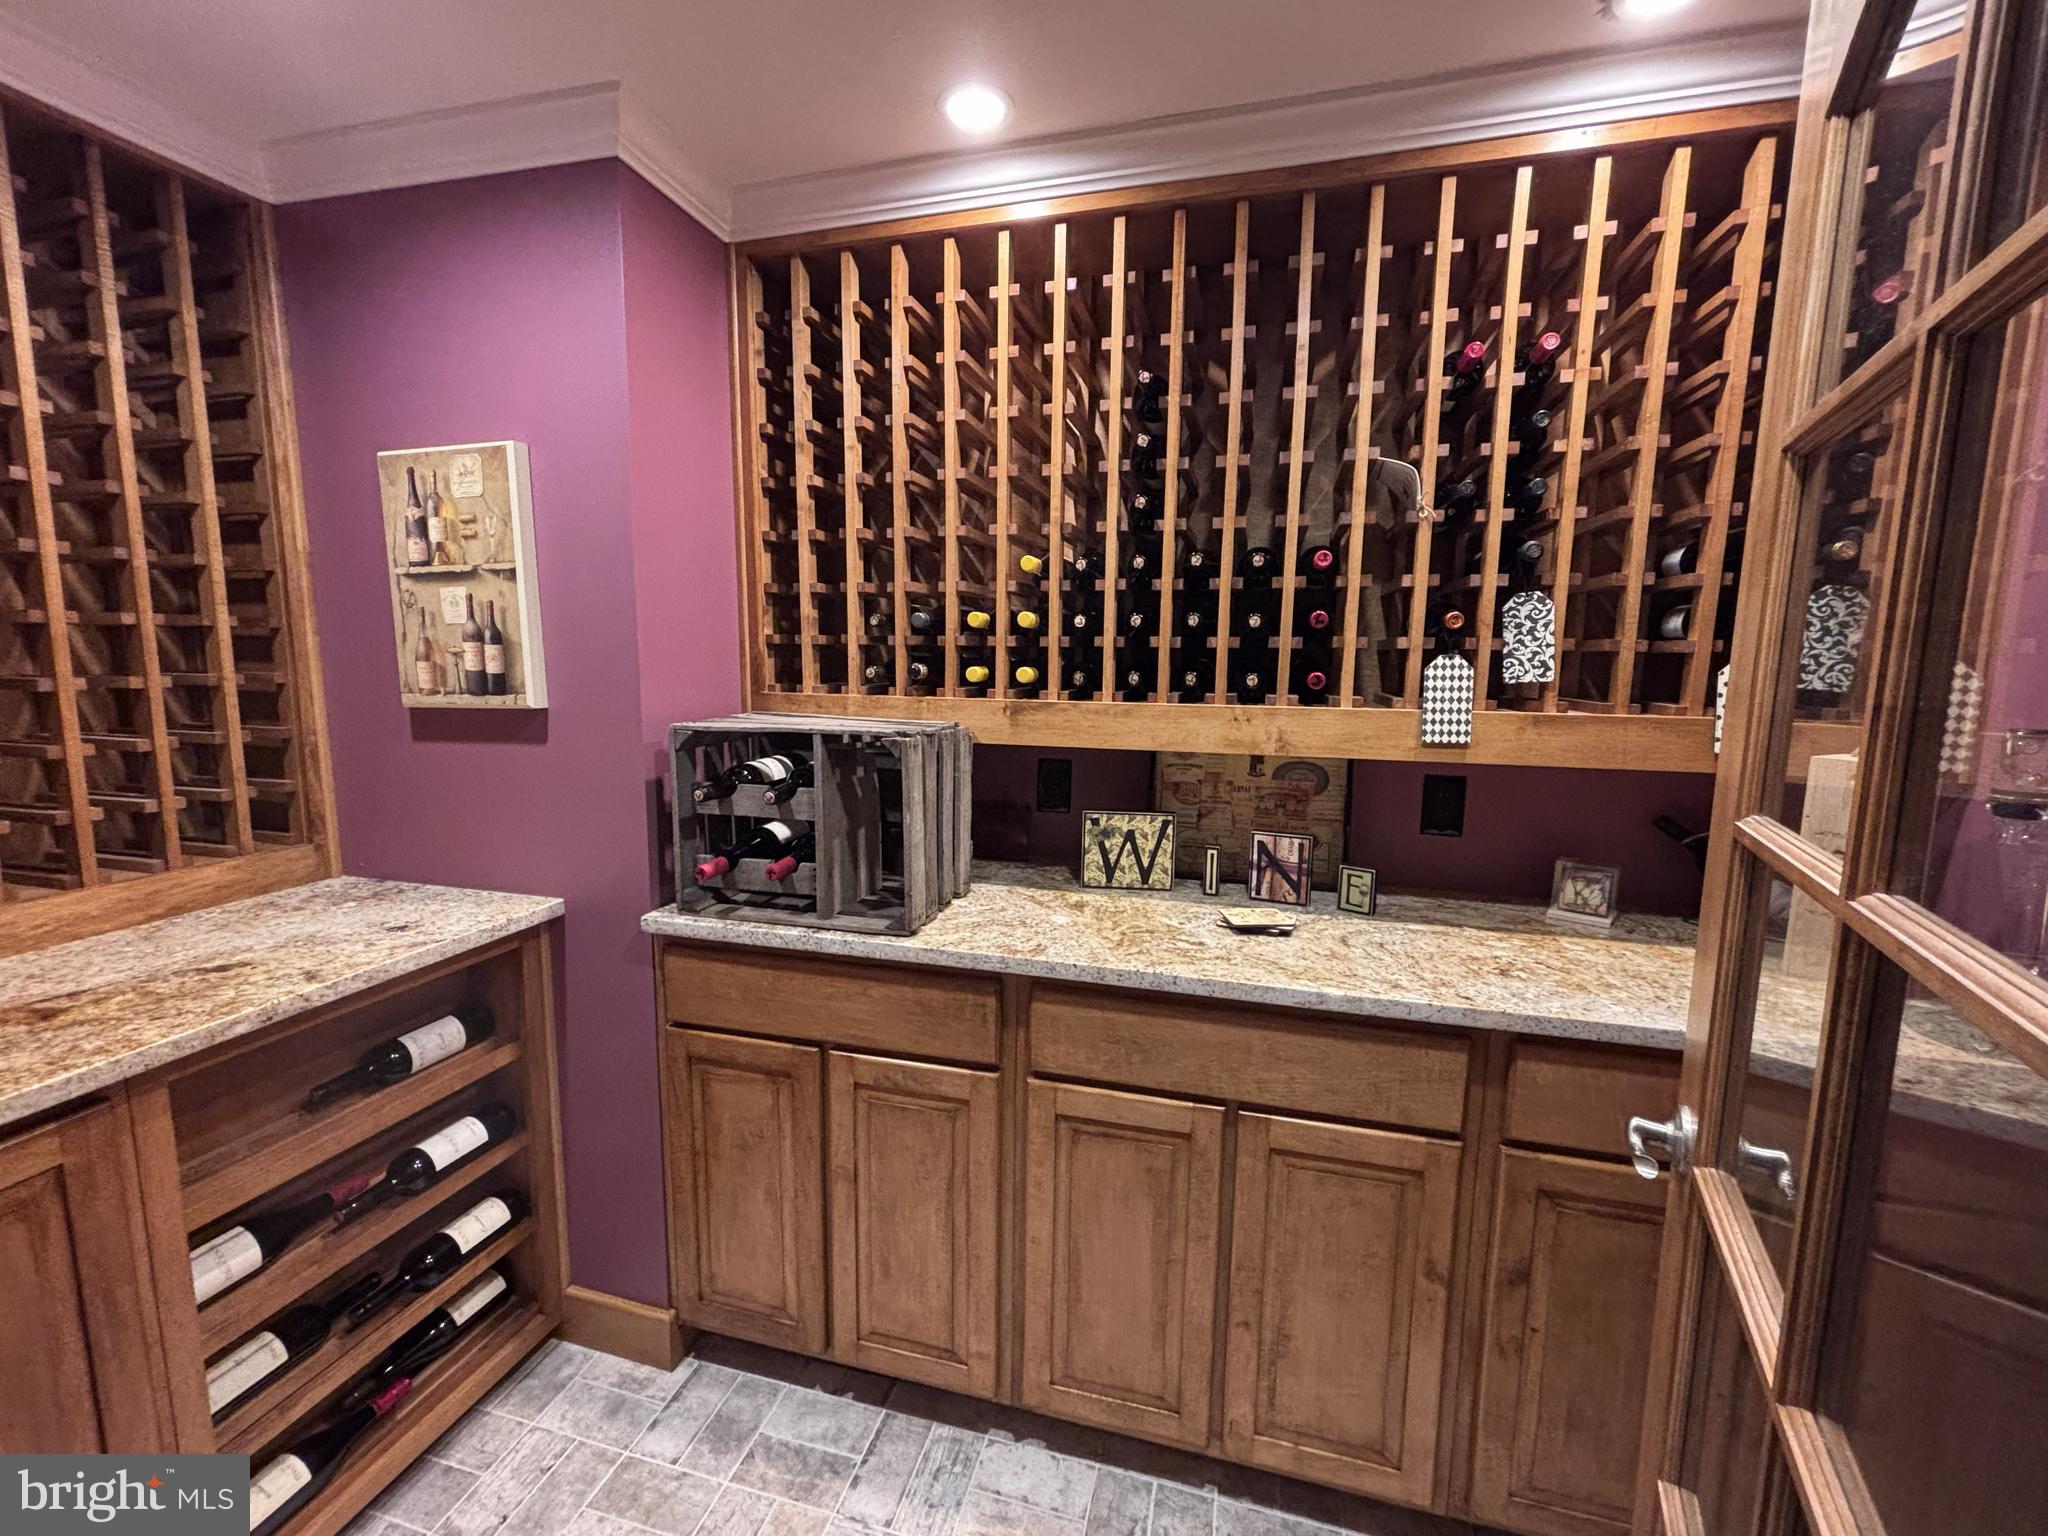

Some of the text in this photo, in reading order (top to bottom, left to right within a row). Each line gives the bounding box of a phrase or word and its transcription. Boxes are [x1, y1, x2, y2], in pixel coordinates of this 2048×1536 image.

[1090, 817, 1172, 885] W
[1255, 840, 1304, 897] N
[1346, 872, 1365, 908] E
